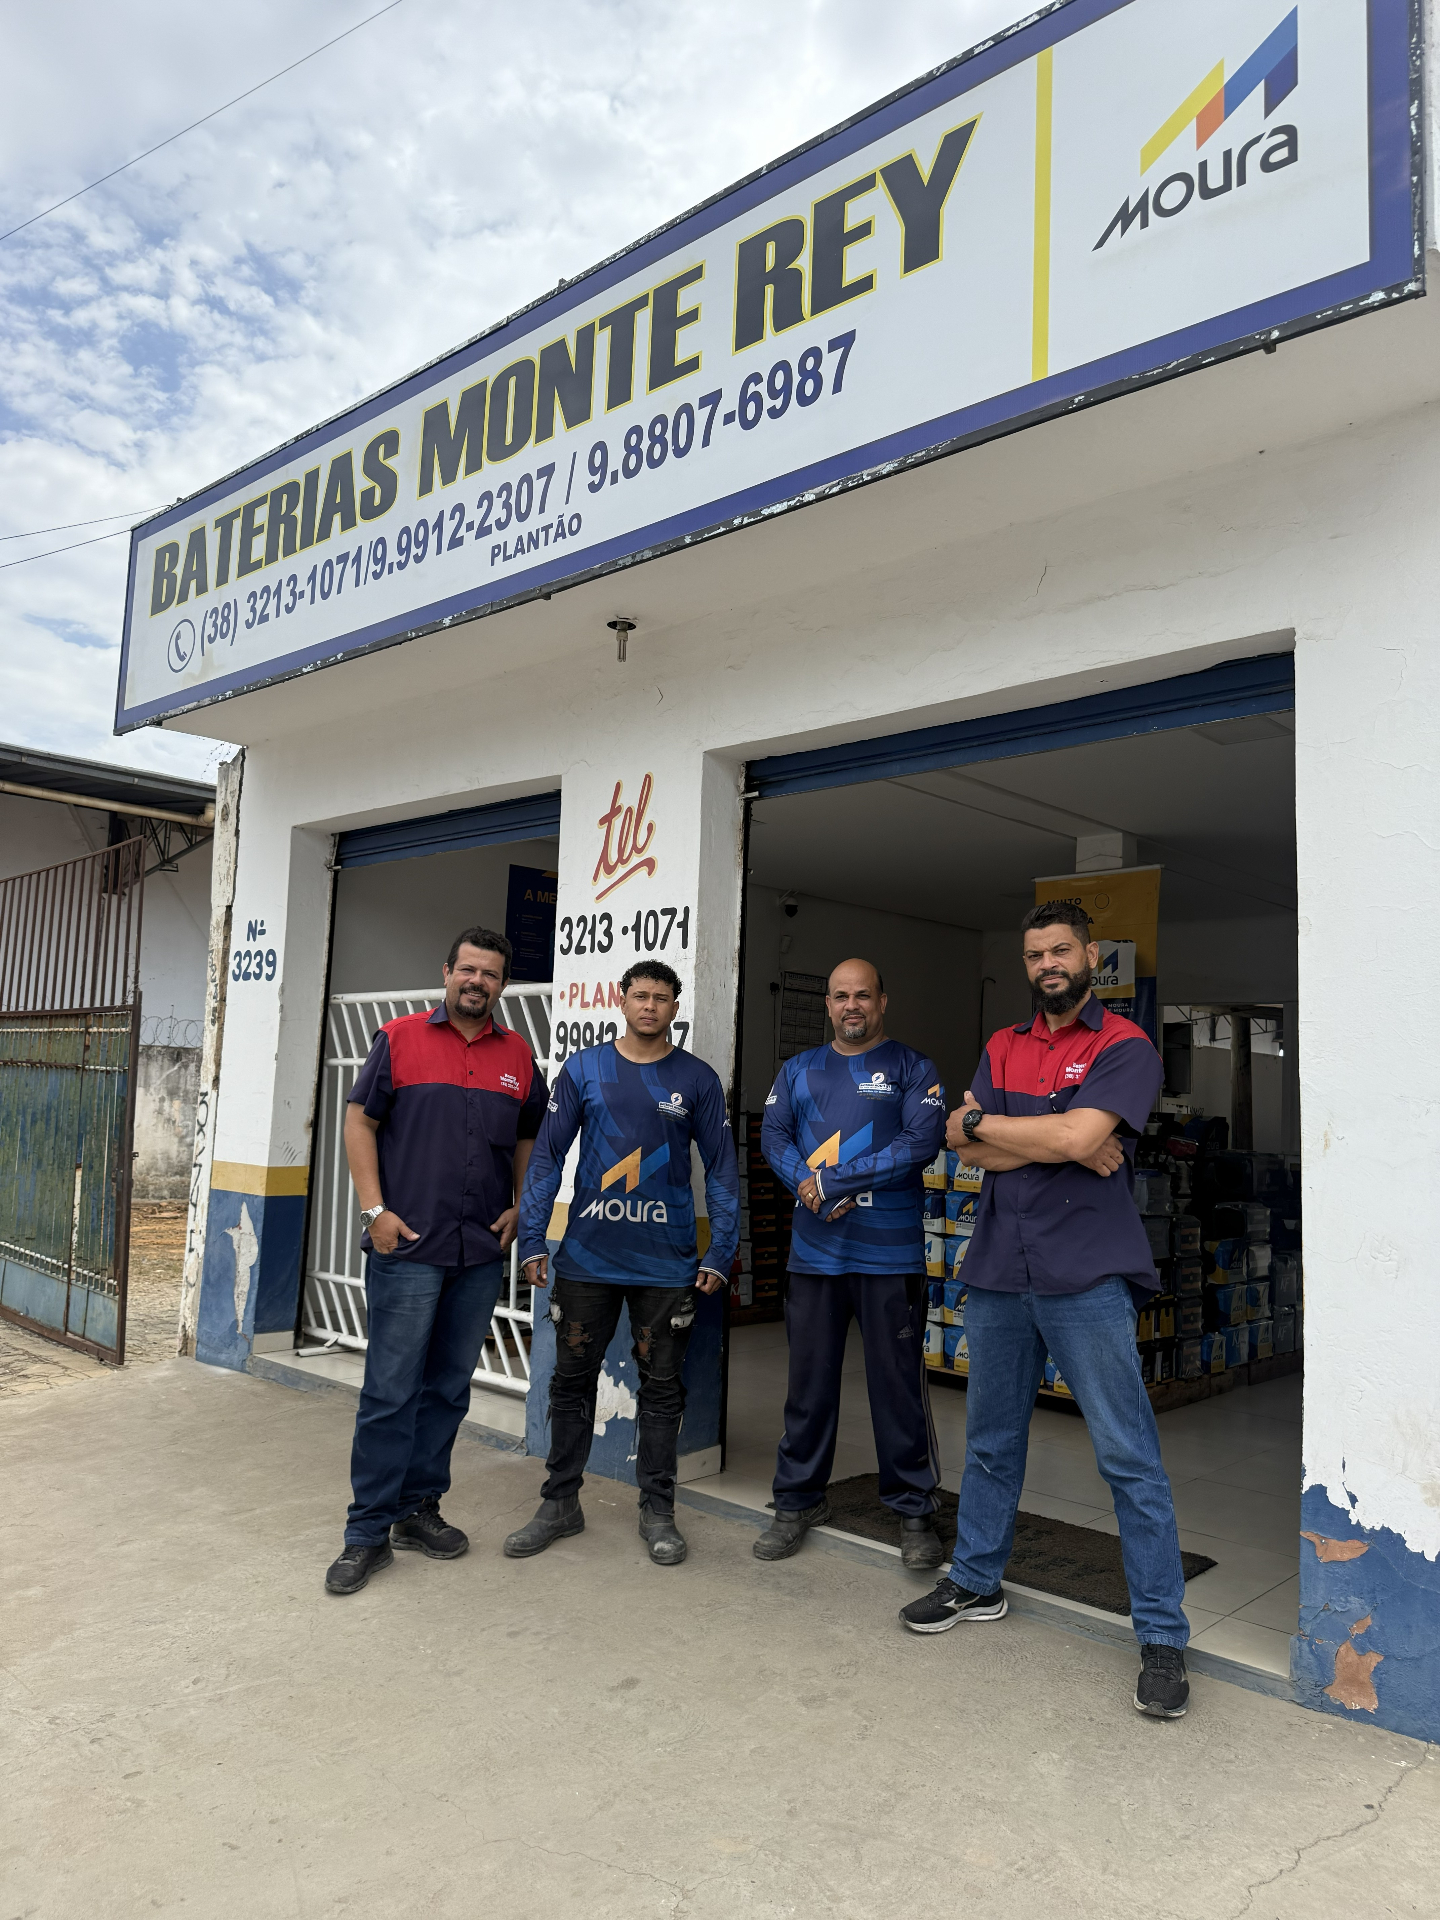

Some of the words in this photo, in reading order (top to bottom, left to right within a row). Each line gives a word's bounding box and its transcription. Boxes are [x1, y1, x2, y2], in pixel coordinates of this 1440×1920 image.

[150, 427, 400, 618] BATERIAS
[417, 260, 706, 500] MONTE
[732, 112, 984, 355] REY
[200, 601, 239, 656] (38)
[587, 329, 856, 493] 9.8807-6987
[490, 513, 582, 566] PLANTÃO
[591, 771, 656, 886] tel
[524, 889, 534, 901] A
[232, 949, 277, 982] 3239
[1091, 974, 1119, 986] oura
[957, 1214, 977, 1223] Mour
